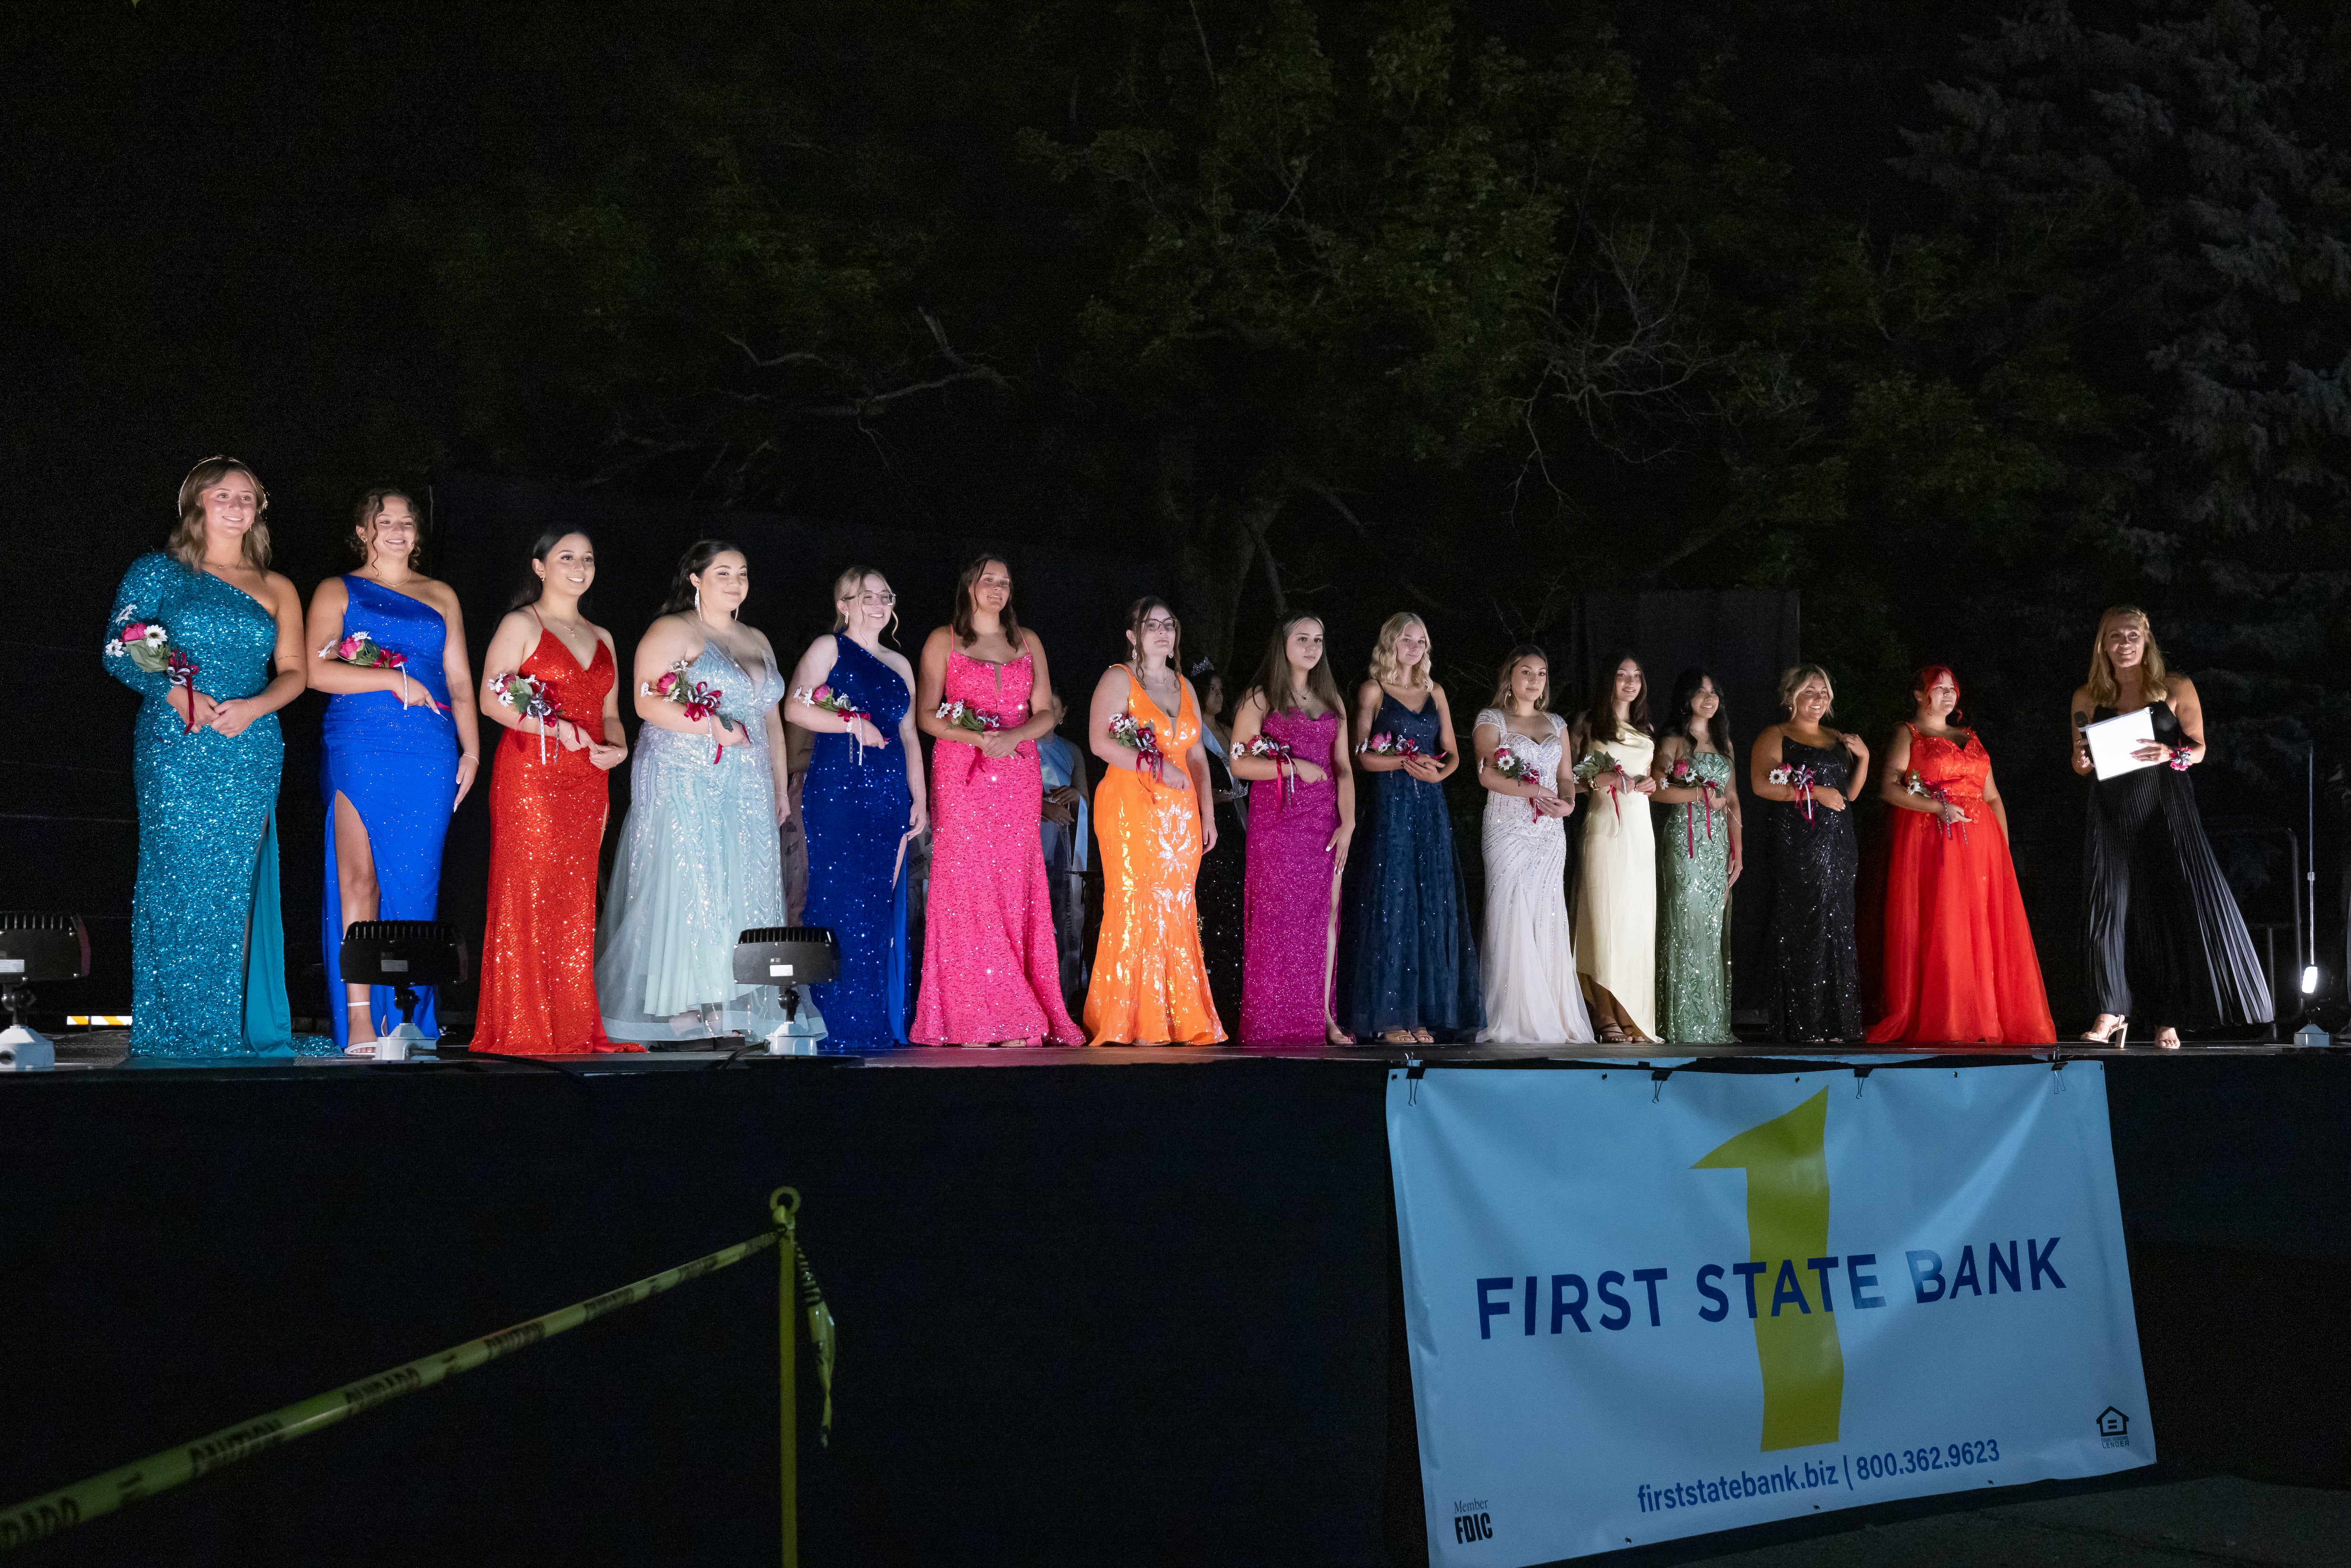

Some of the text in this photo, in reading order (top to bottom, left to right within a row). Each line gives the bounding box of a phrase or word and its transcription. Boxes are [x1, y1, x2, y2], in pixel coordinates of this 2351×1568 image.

[1476, 1237, 2067, 1339] FIRST STATE BANK
[1638, 1459, 1838, 1513] firststatebank.biz
[1856, 1439, 2000, 1481] 800.362.9623
[1454, 1498, 1488, 1513] Member
[1455, 1512, 1493, 1544] FDIC
